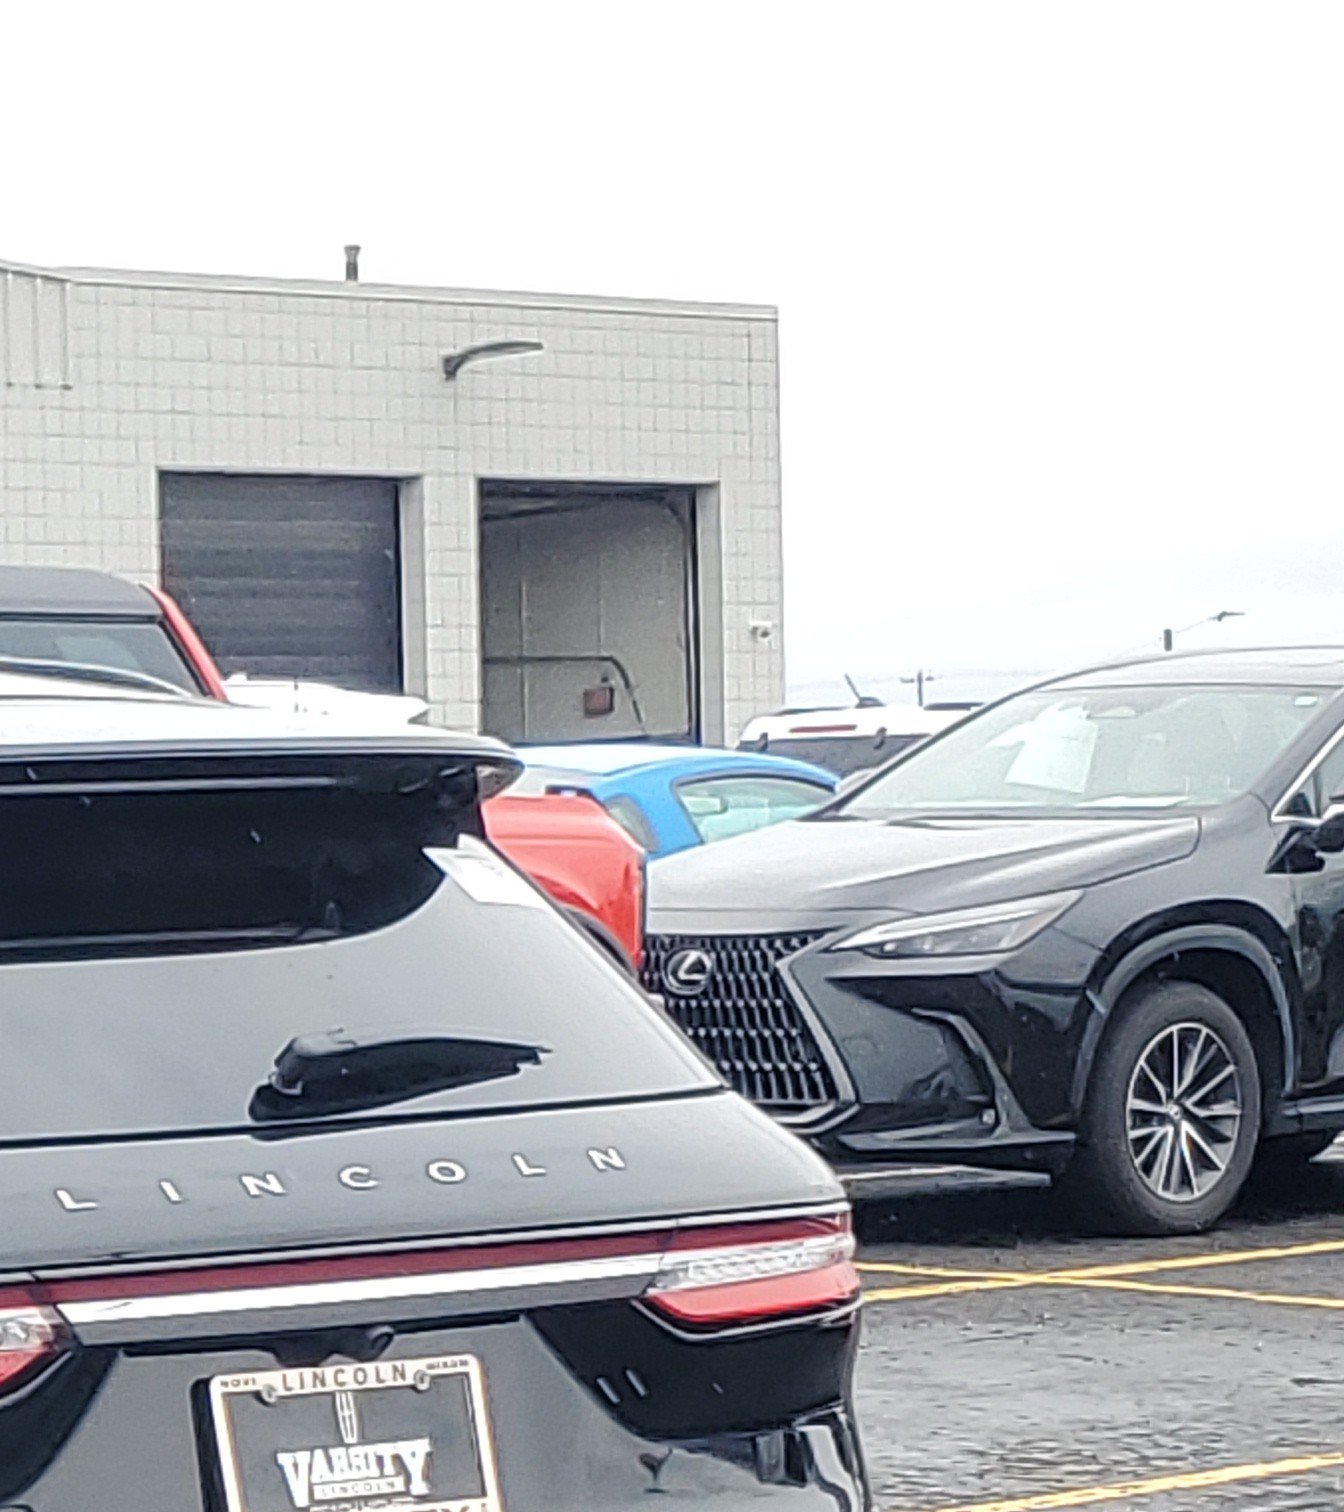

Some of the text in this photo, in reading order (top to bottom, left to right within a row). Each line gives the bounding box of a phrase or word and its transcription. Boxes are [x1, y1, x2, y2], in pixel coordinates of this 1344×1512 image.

[54, 1145, 628, 1214] LINCOLN
[281, 1363, 407, 1391] LINCOLN
[275, 1437, 433, 1508] VARSITY
[321, 1481, 397, 1497] LINCOLN
